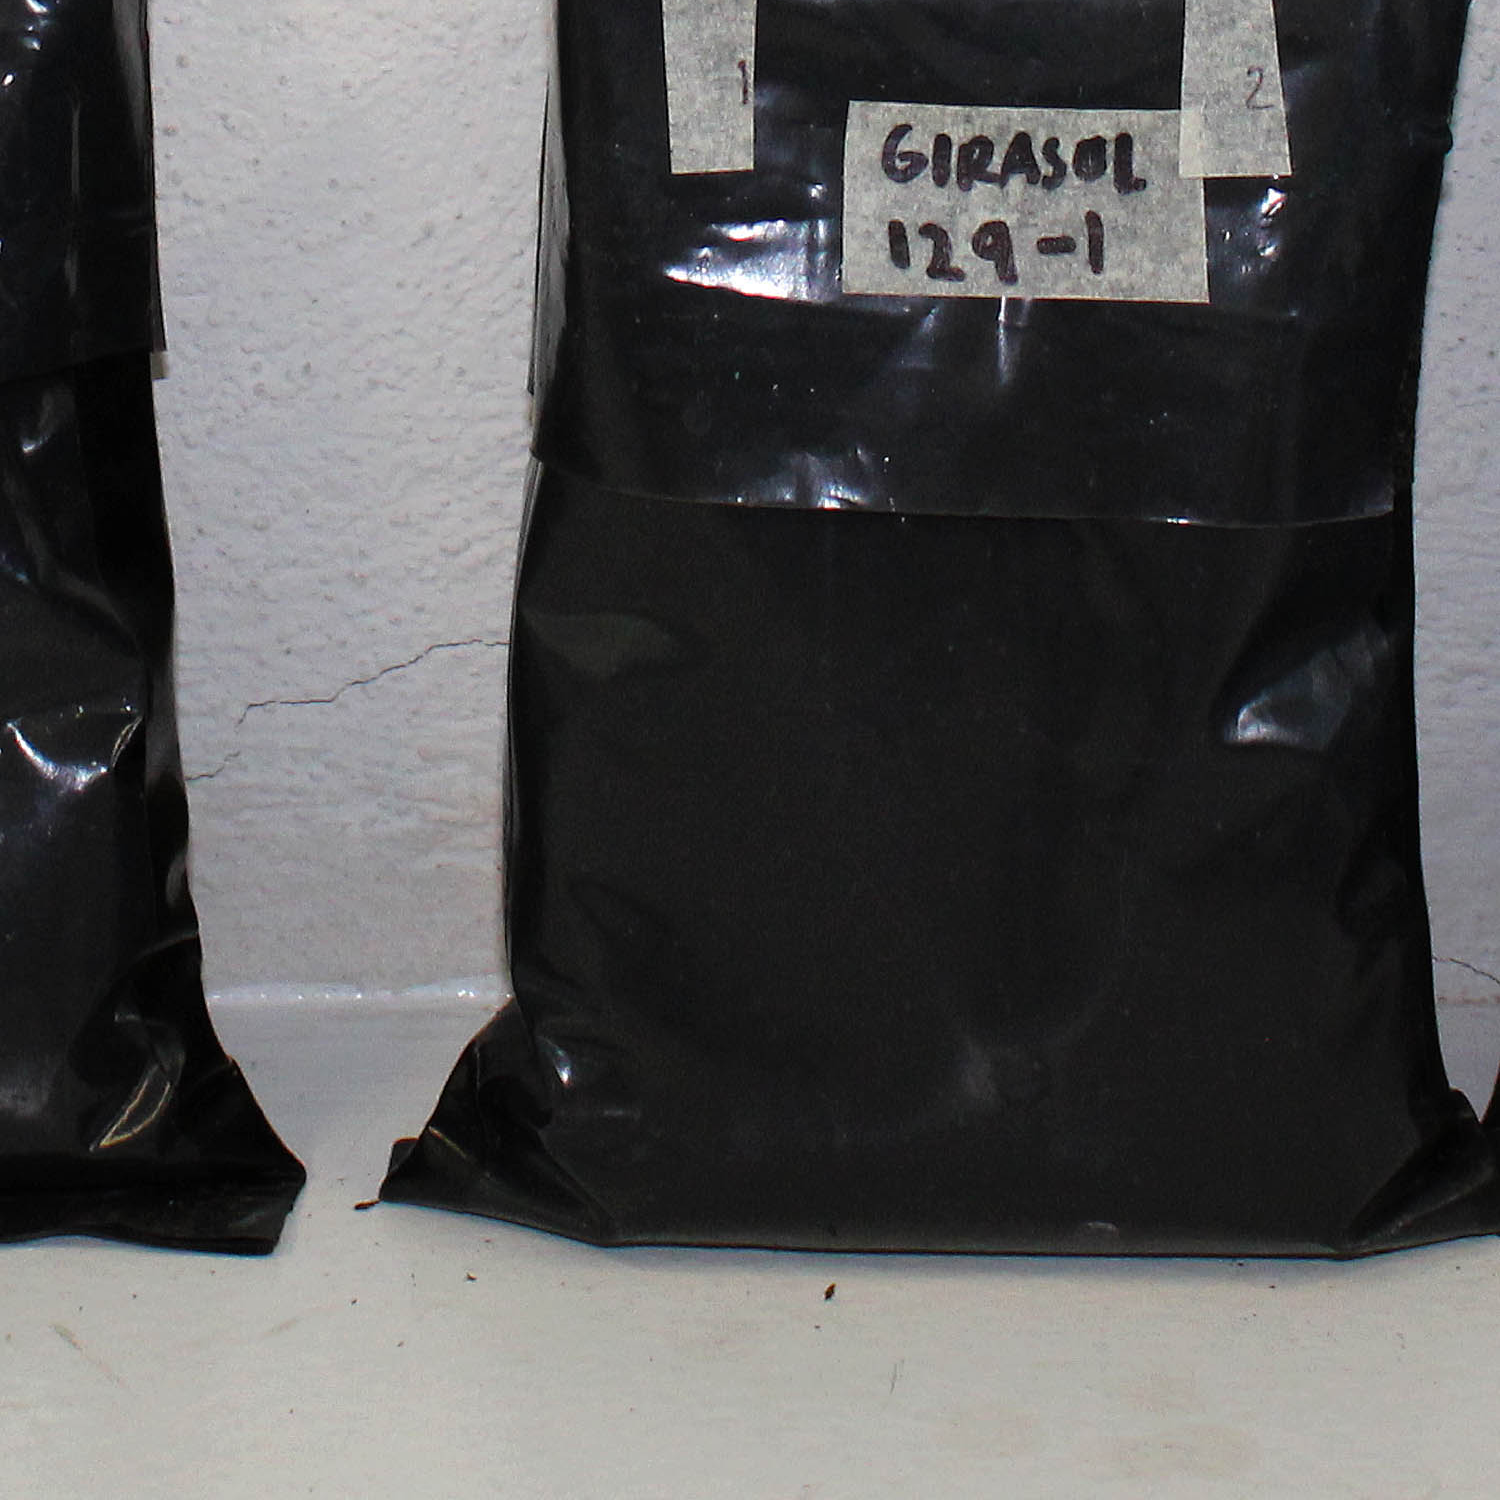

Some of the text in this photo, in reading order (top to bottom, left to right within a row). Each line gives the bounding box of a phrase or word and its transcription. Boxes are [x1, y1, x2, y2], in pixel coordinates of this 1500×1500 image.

[738, 59, 749, 105] 1
[1246, 66, 1274, 110] 2
[881, 123, 1147, 194] GIRASOL
[888, 211, 1104, 285] 129-1
